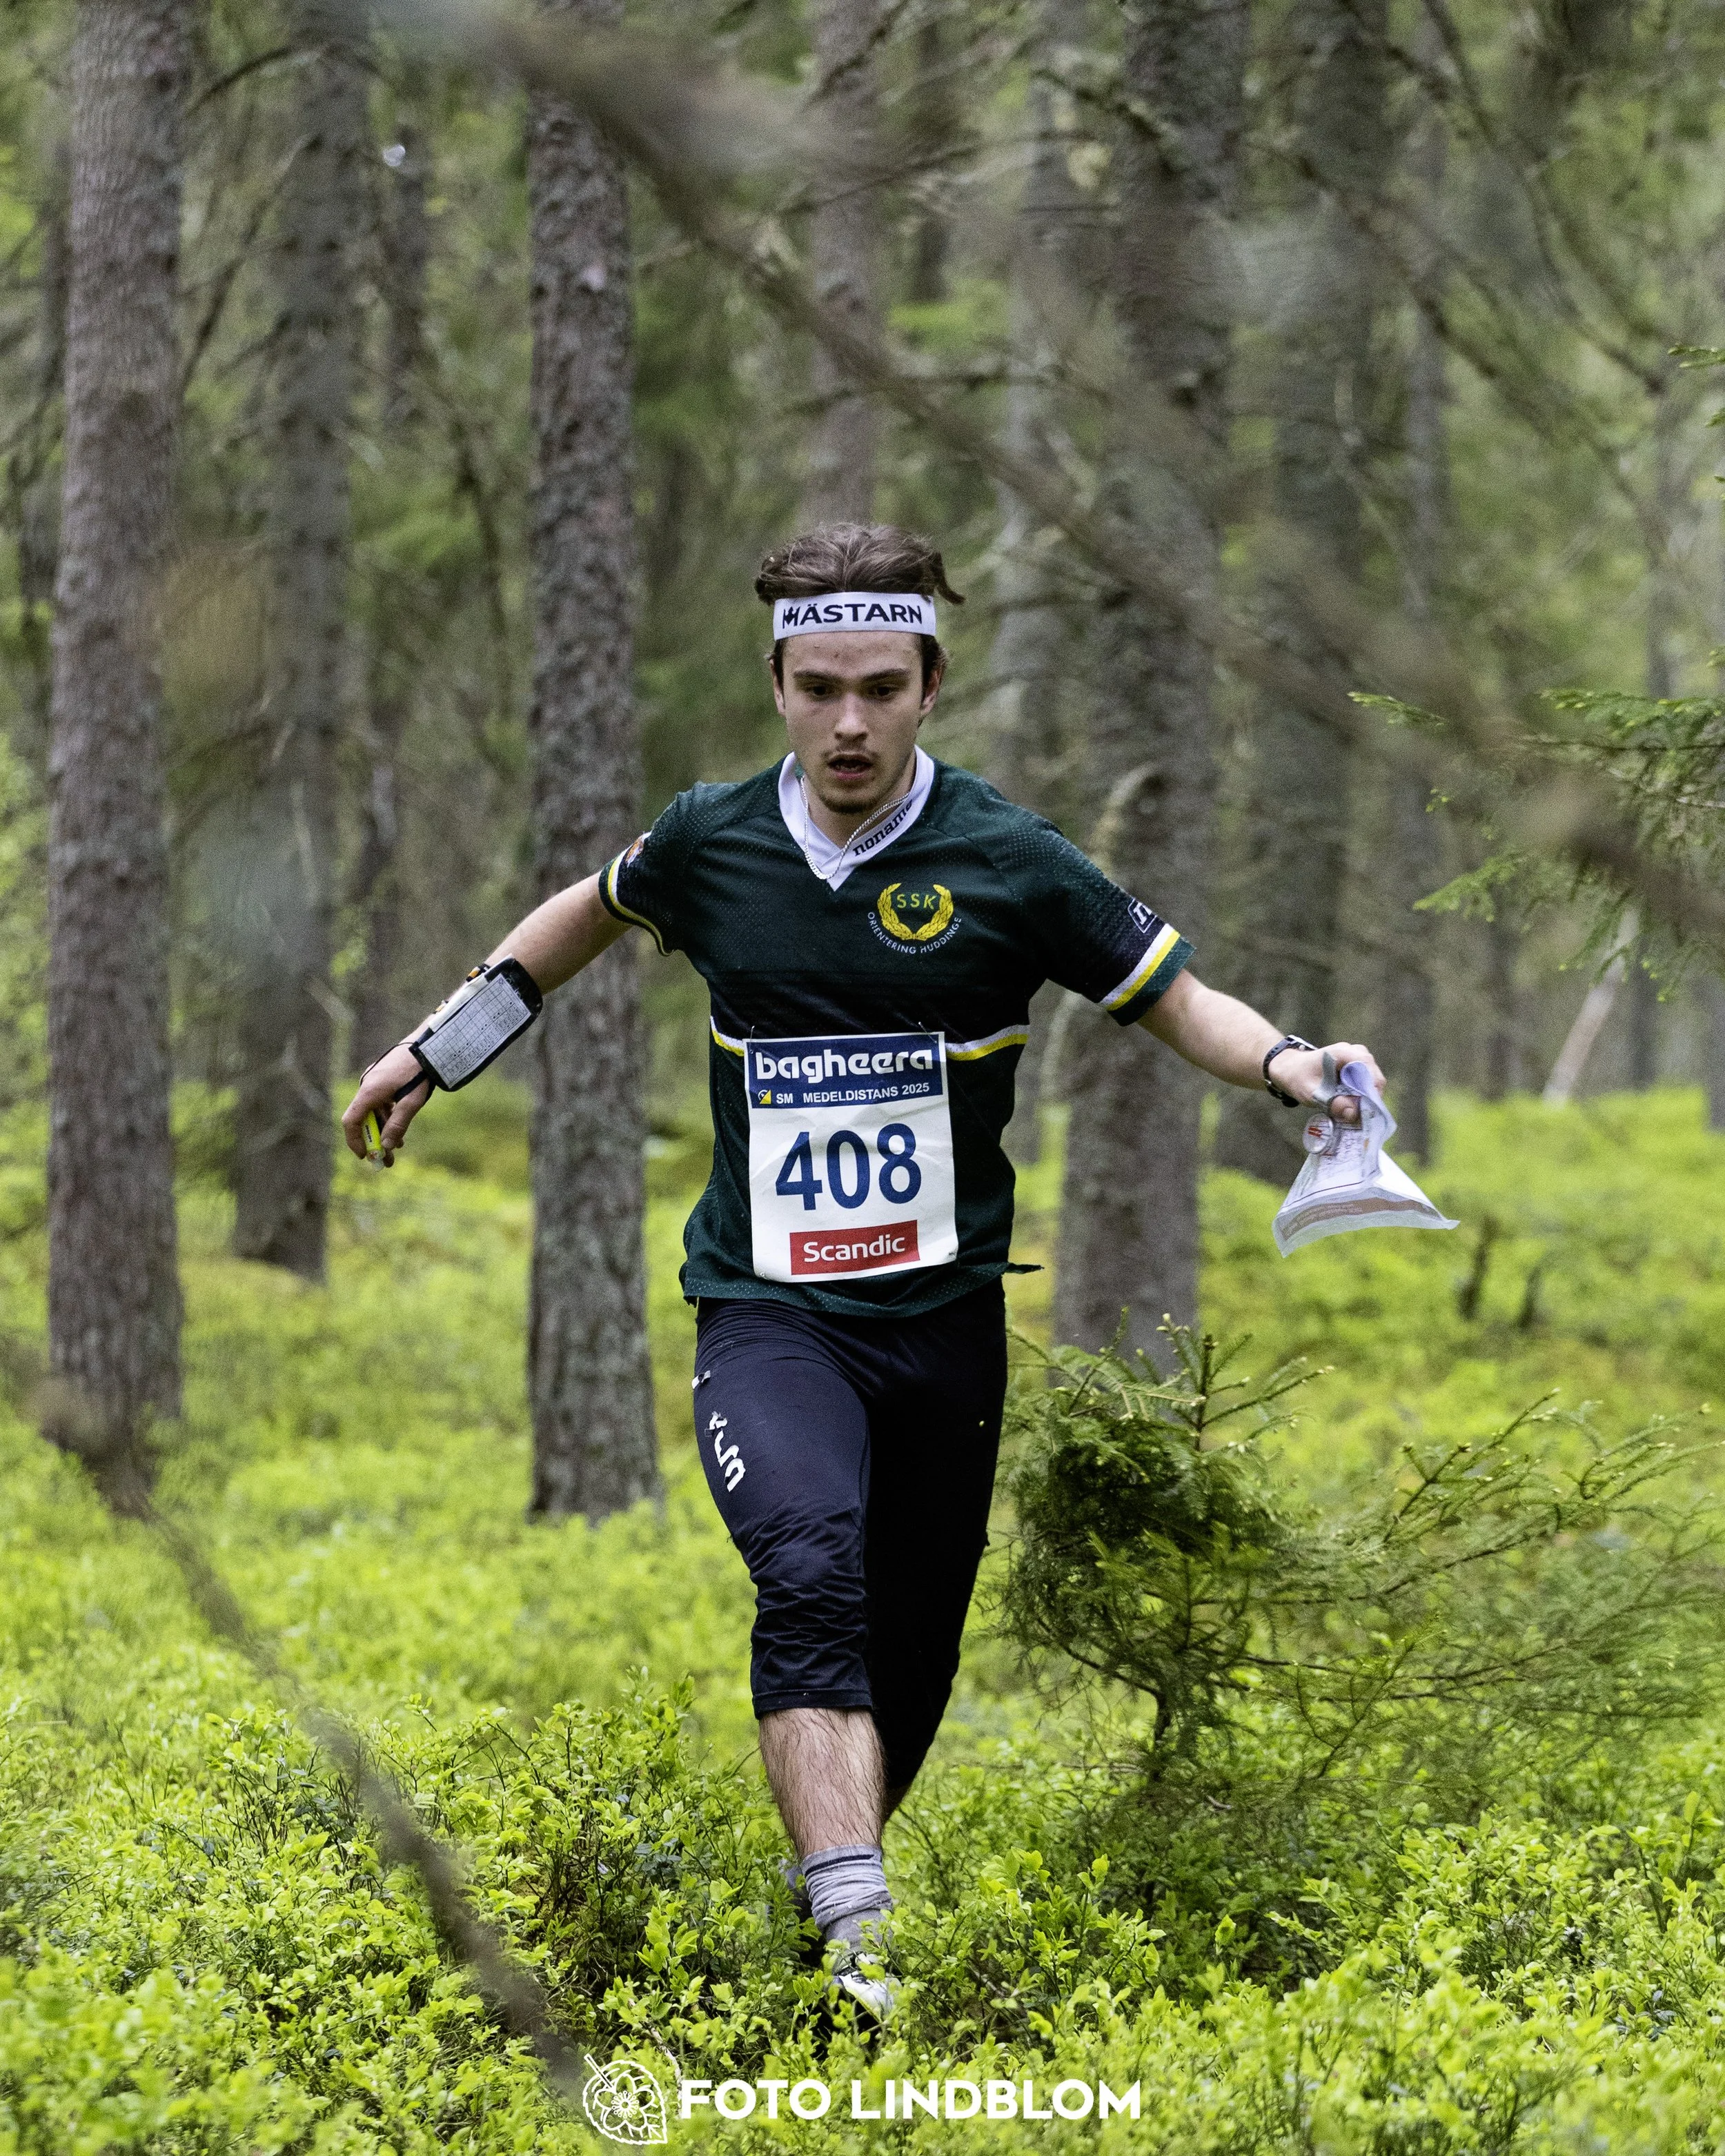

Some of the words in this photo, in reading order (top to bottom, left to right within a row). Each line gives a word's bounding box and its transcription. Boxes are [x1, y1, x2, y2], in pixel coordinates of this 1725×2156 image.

[782, 603, 923, 629] MÄSTARN
[896, 893, 937, 909] SSK
[867, 911, 917, 954] ORIENTERING
[920, 917, 962, 953] HUDDINGE
[755, 1049, 934, 1084] bagheera
[776, 1092, 793, 1105] SM
[802, 1086, 898, 1103] MEDELDISTANS
[901, 1082, 930, 1096] 2025
[775, 1122, 922, 1211] 408
[802, 1234, 905, 1263] Scandic
